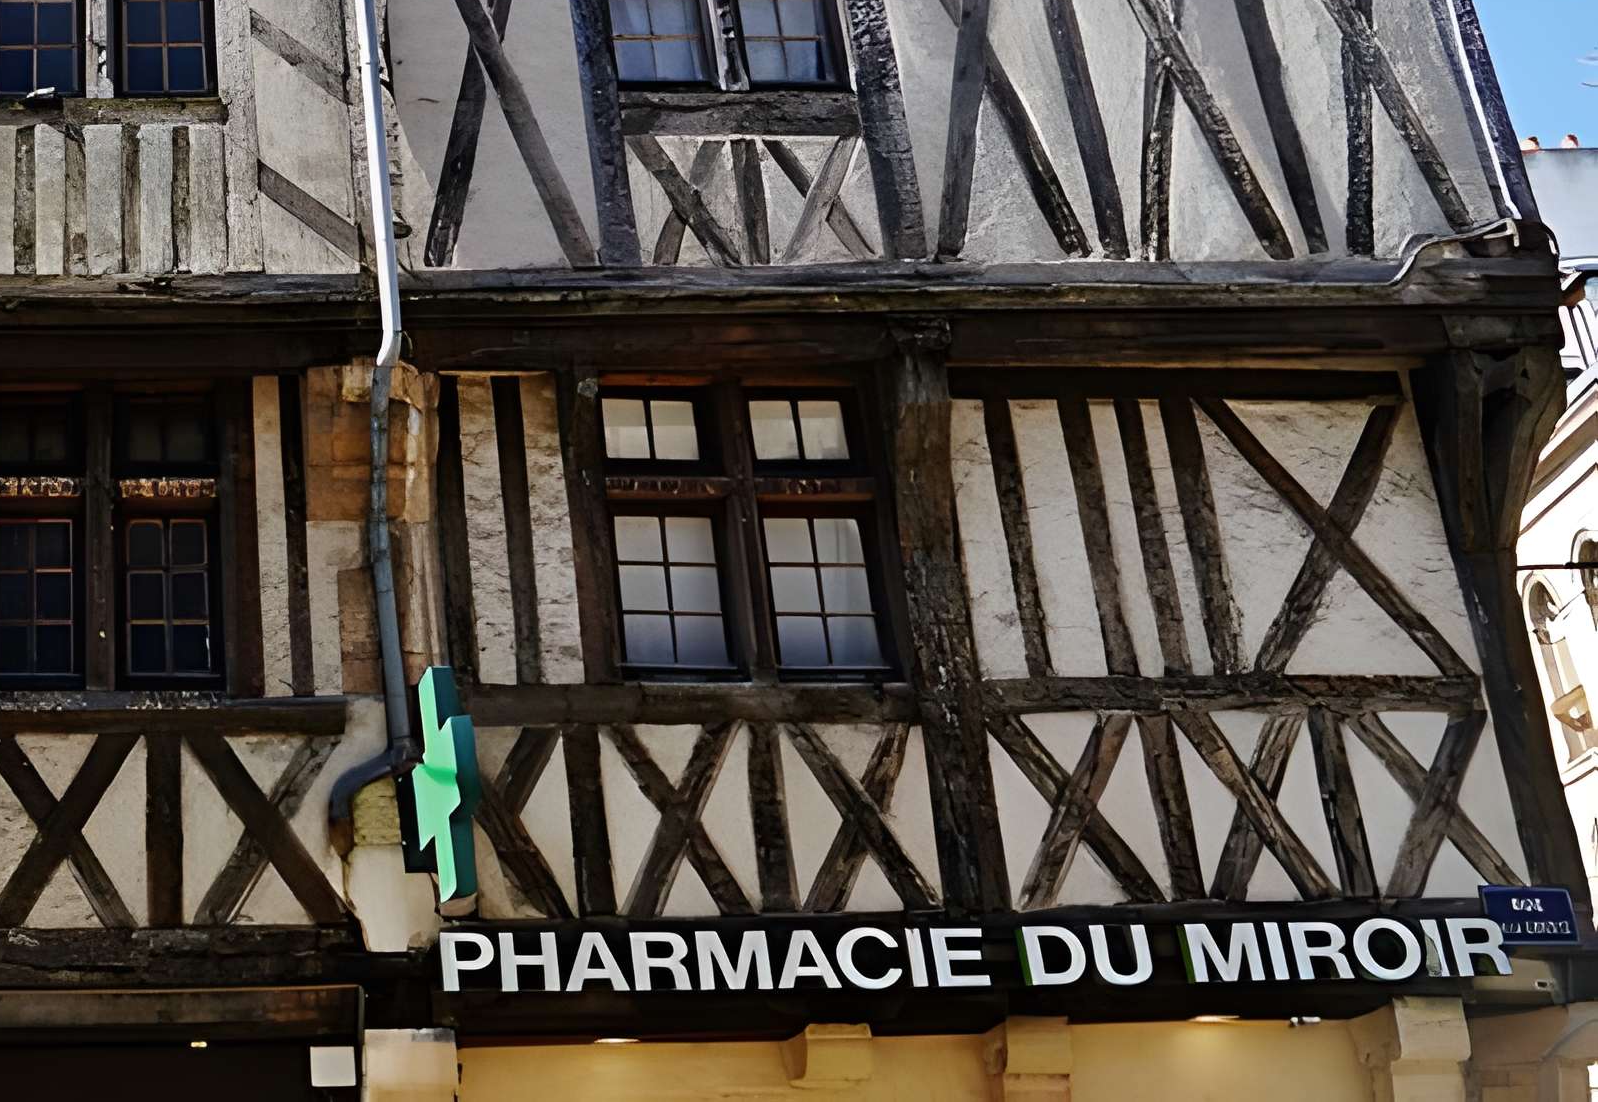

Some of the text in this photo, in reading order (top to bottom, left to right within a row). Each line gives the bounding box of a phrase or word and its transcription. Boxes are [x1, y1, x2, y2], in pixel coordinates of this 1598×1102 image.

[439, 918, 1514, 992] PHARMACIE DU MIROIR
